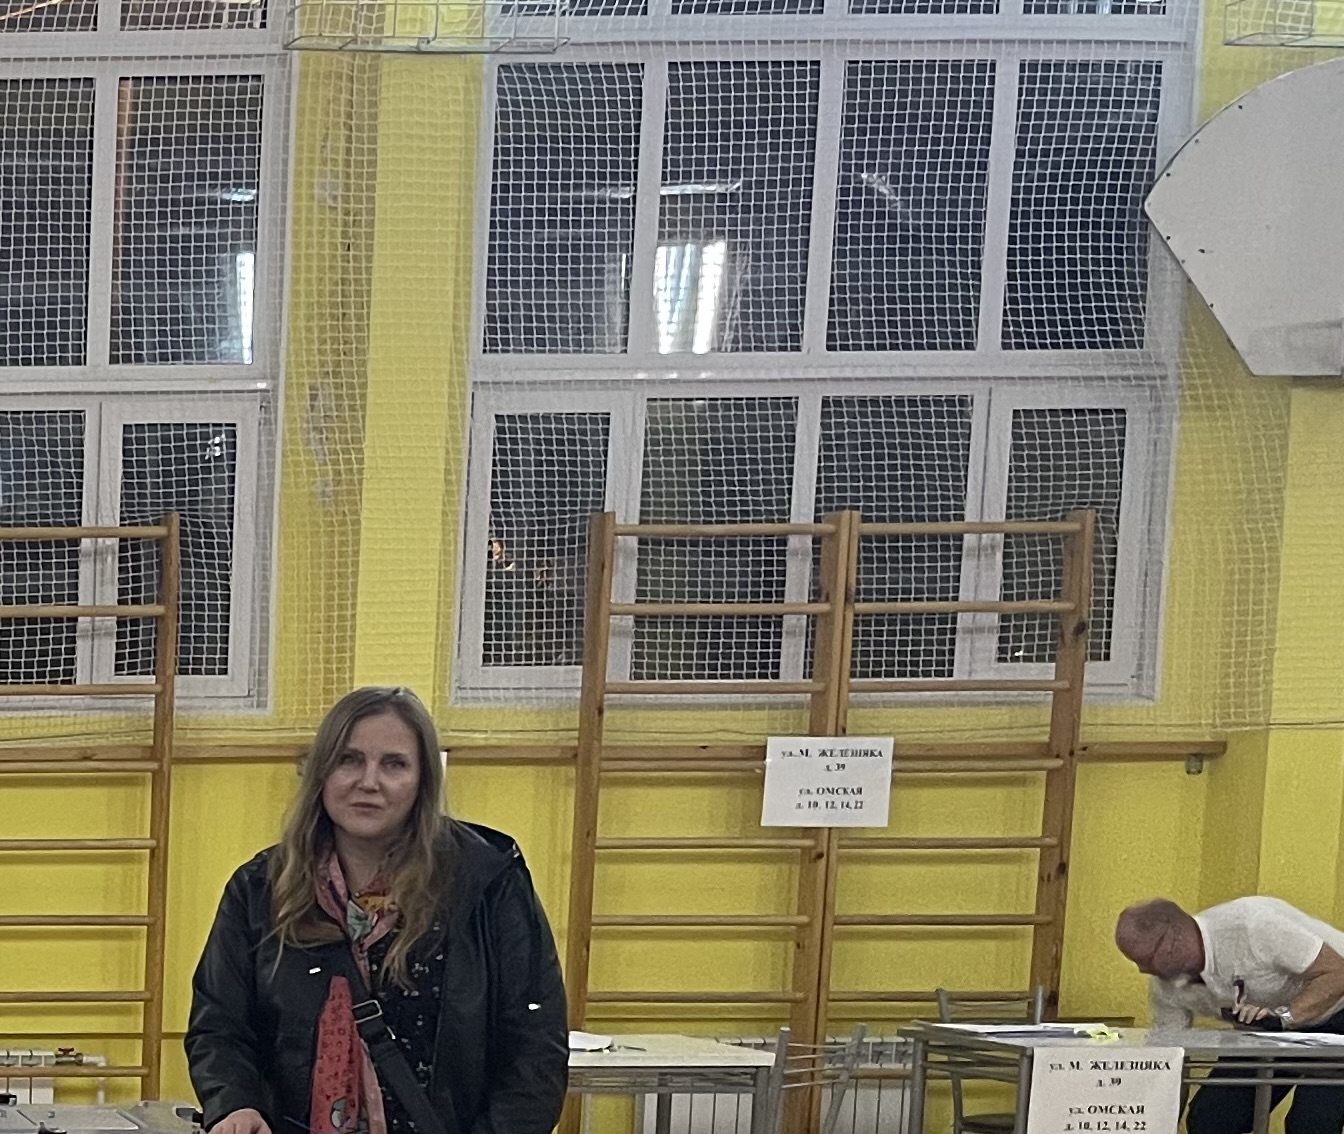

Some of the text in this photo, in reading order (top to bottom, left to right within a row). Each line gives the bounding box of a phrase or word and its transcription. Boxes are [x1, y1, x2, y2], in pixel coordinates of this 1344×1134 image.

[816, 786, 863, 796] ОМСКАЯ
[1090, 1061, 1171, 1071] ЖЕЛЕЗНЯКА
[1087, 1105, 1145, 1115] ОМСКАЯ
[1078, 1121, 1093, 1132] 10,
[1097, 1121, 1111, 1132] 12,
[1115, 1121, 1131, 1132] 14,
[1133, 1121, 1147, 1131] 22
